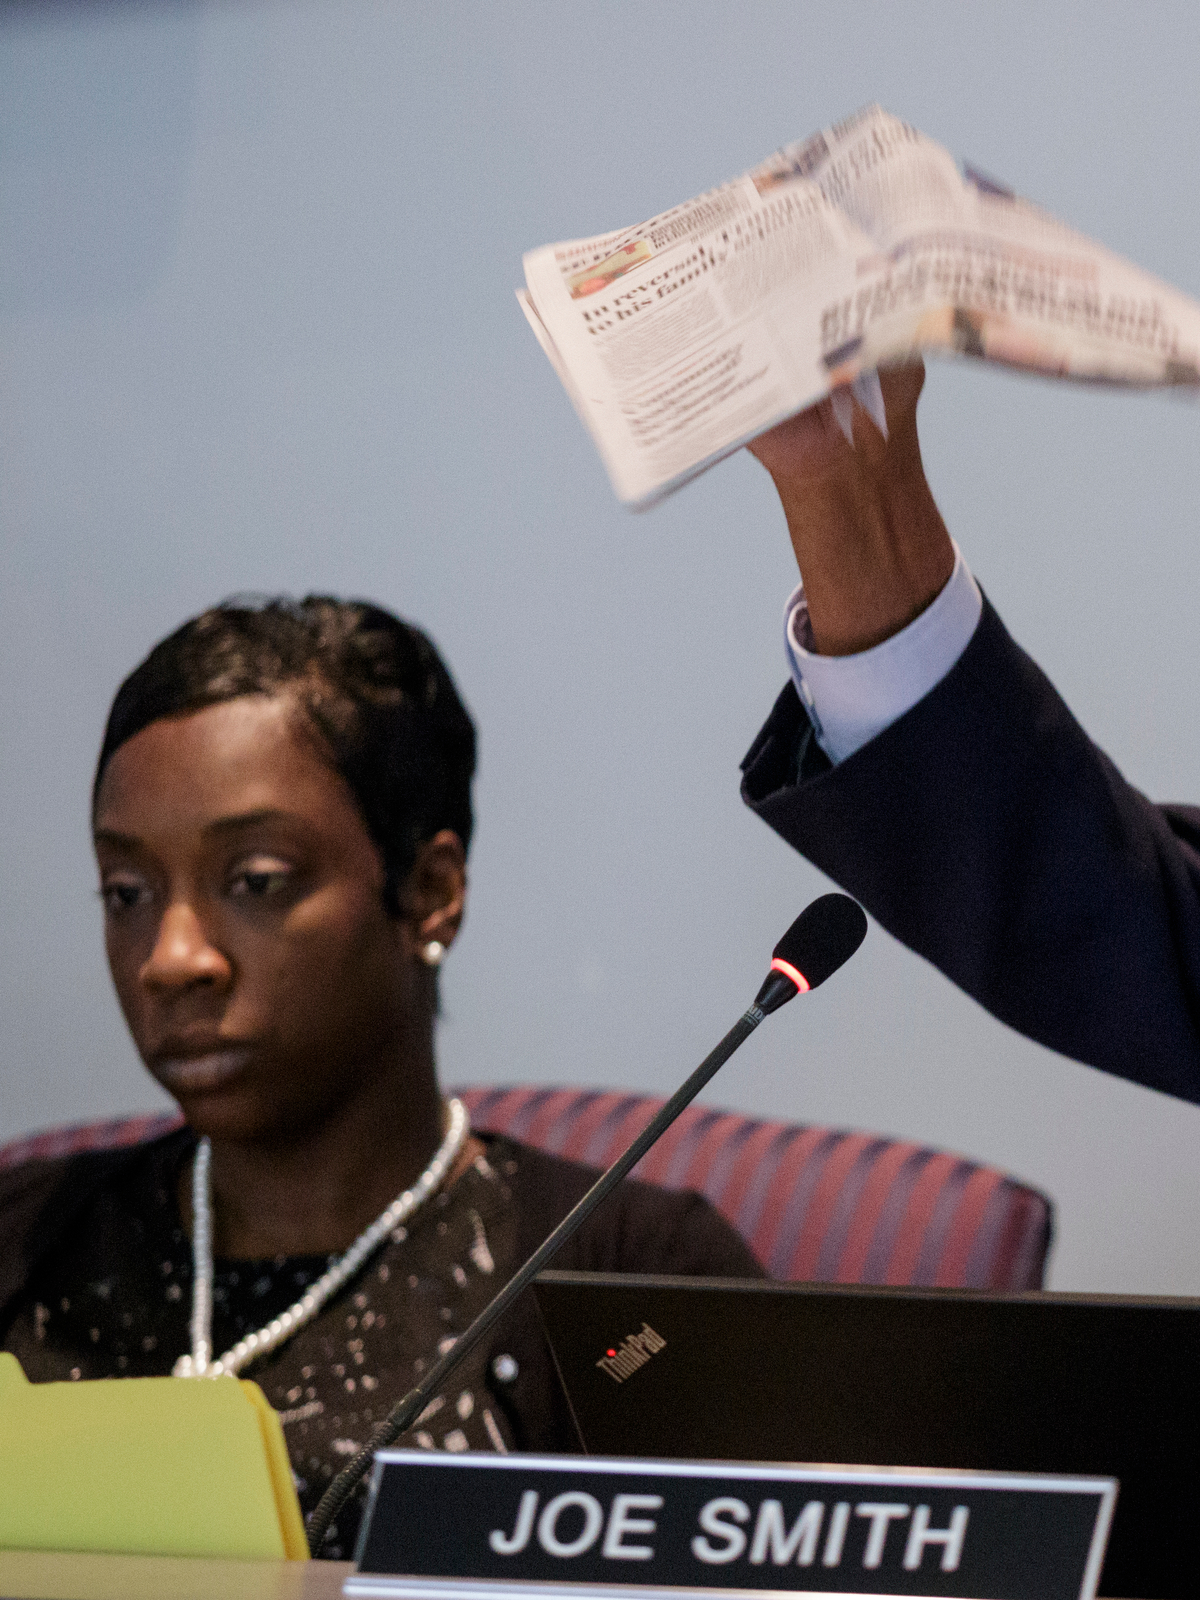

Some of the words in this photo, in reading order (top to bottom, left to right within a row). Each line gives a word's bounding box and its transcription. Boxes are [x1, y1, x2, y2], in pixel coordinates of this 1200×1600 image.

[595, 1322, 667, 1383] ThinkPad
[489, 1489, 664, 1561] JOE
[691, 1496, 970, 1572] SMITH
